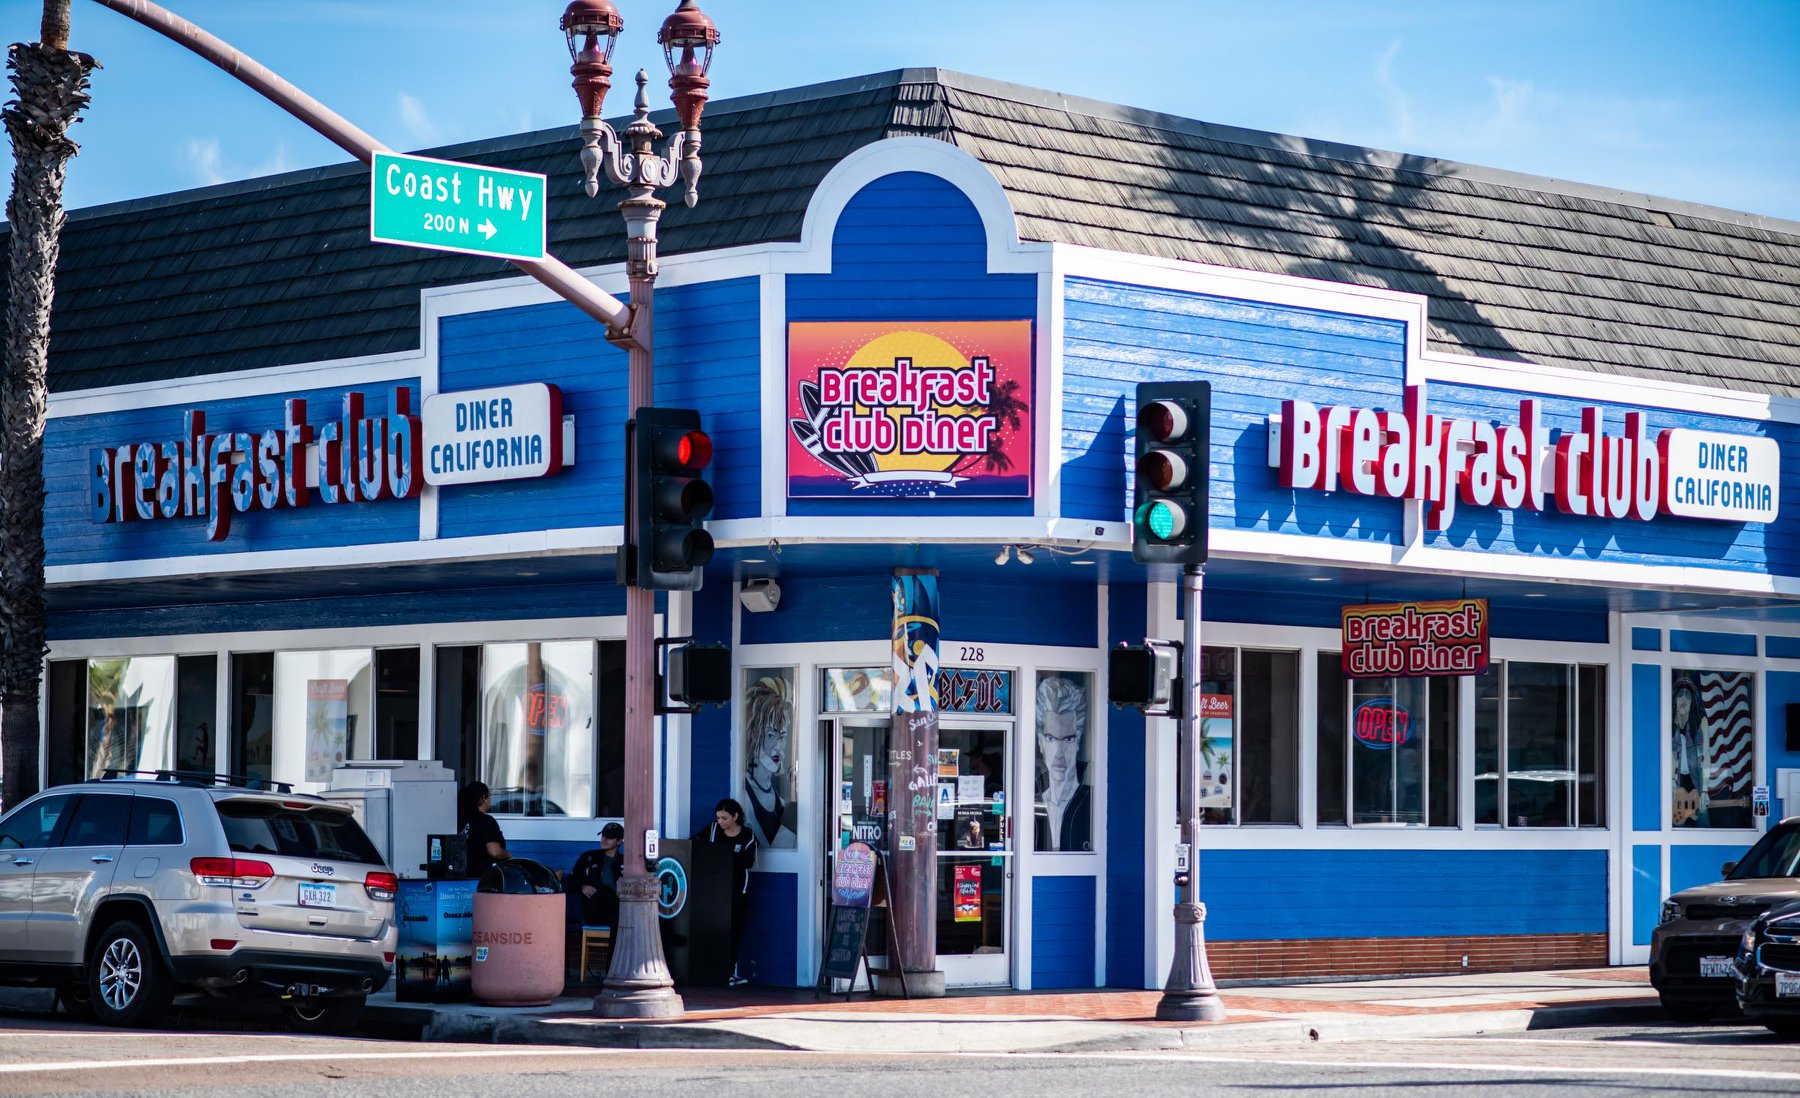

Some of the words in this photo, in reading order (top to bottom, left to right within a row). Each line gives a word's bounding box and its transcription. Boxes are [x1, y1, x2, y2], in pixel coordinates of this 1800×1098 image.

[386, 163, 462, 204] Coast
[478, 175, 533, 221] Hwy
[424, 212, 455, 232] 200
[459, 217, 469, 234] N
[820, 359, 993, 415] Breakfast
[456, 397, 513, 432] DINER
[903, 410, 996, 453] Diner
[90, 399, 309, 542] Breakfast
[431, 434, 542, 474] CALIFORNIA
[1283, 385, 1549, 531] Breakfast
[1698, 441, 1748, 473] DINER
[1675, 476, 1771, 511] CALIFORNIA
[1348, 605, 1479, 645] Breakfast
[960, 647, 984, 662] 228
[1410, 643, 1482, 671] Diner
[521, 691, 568, 728] OPEN
[1209, 697, 1229, 710] Beer
[1356, 706, 1409, 744] OPEN
[941, 788, 949, 803] A
[852, 825, 882, 840] NITRO
[311, 863, 334, 876] Jeep
[318, 890, 331, 903] 322
